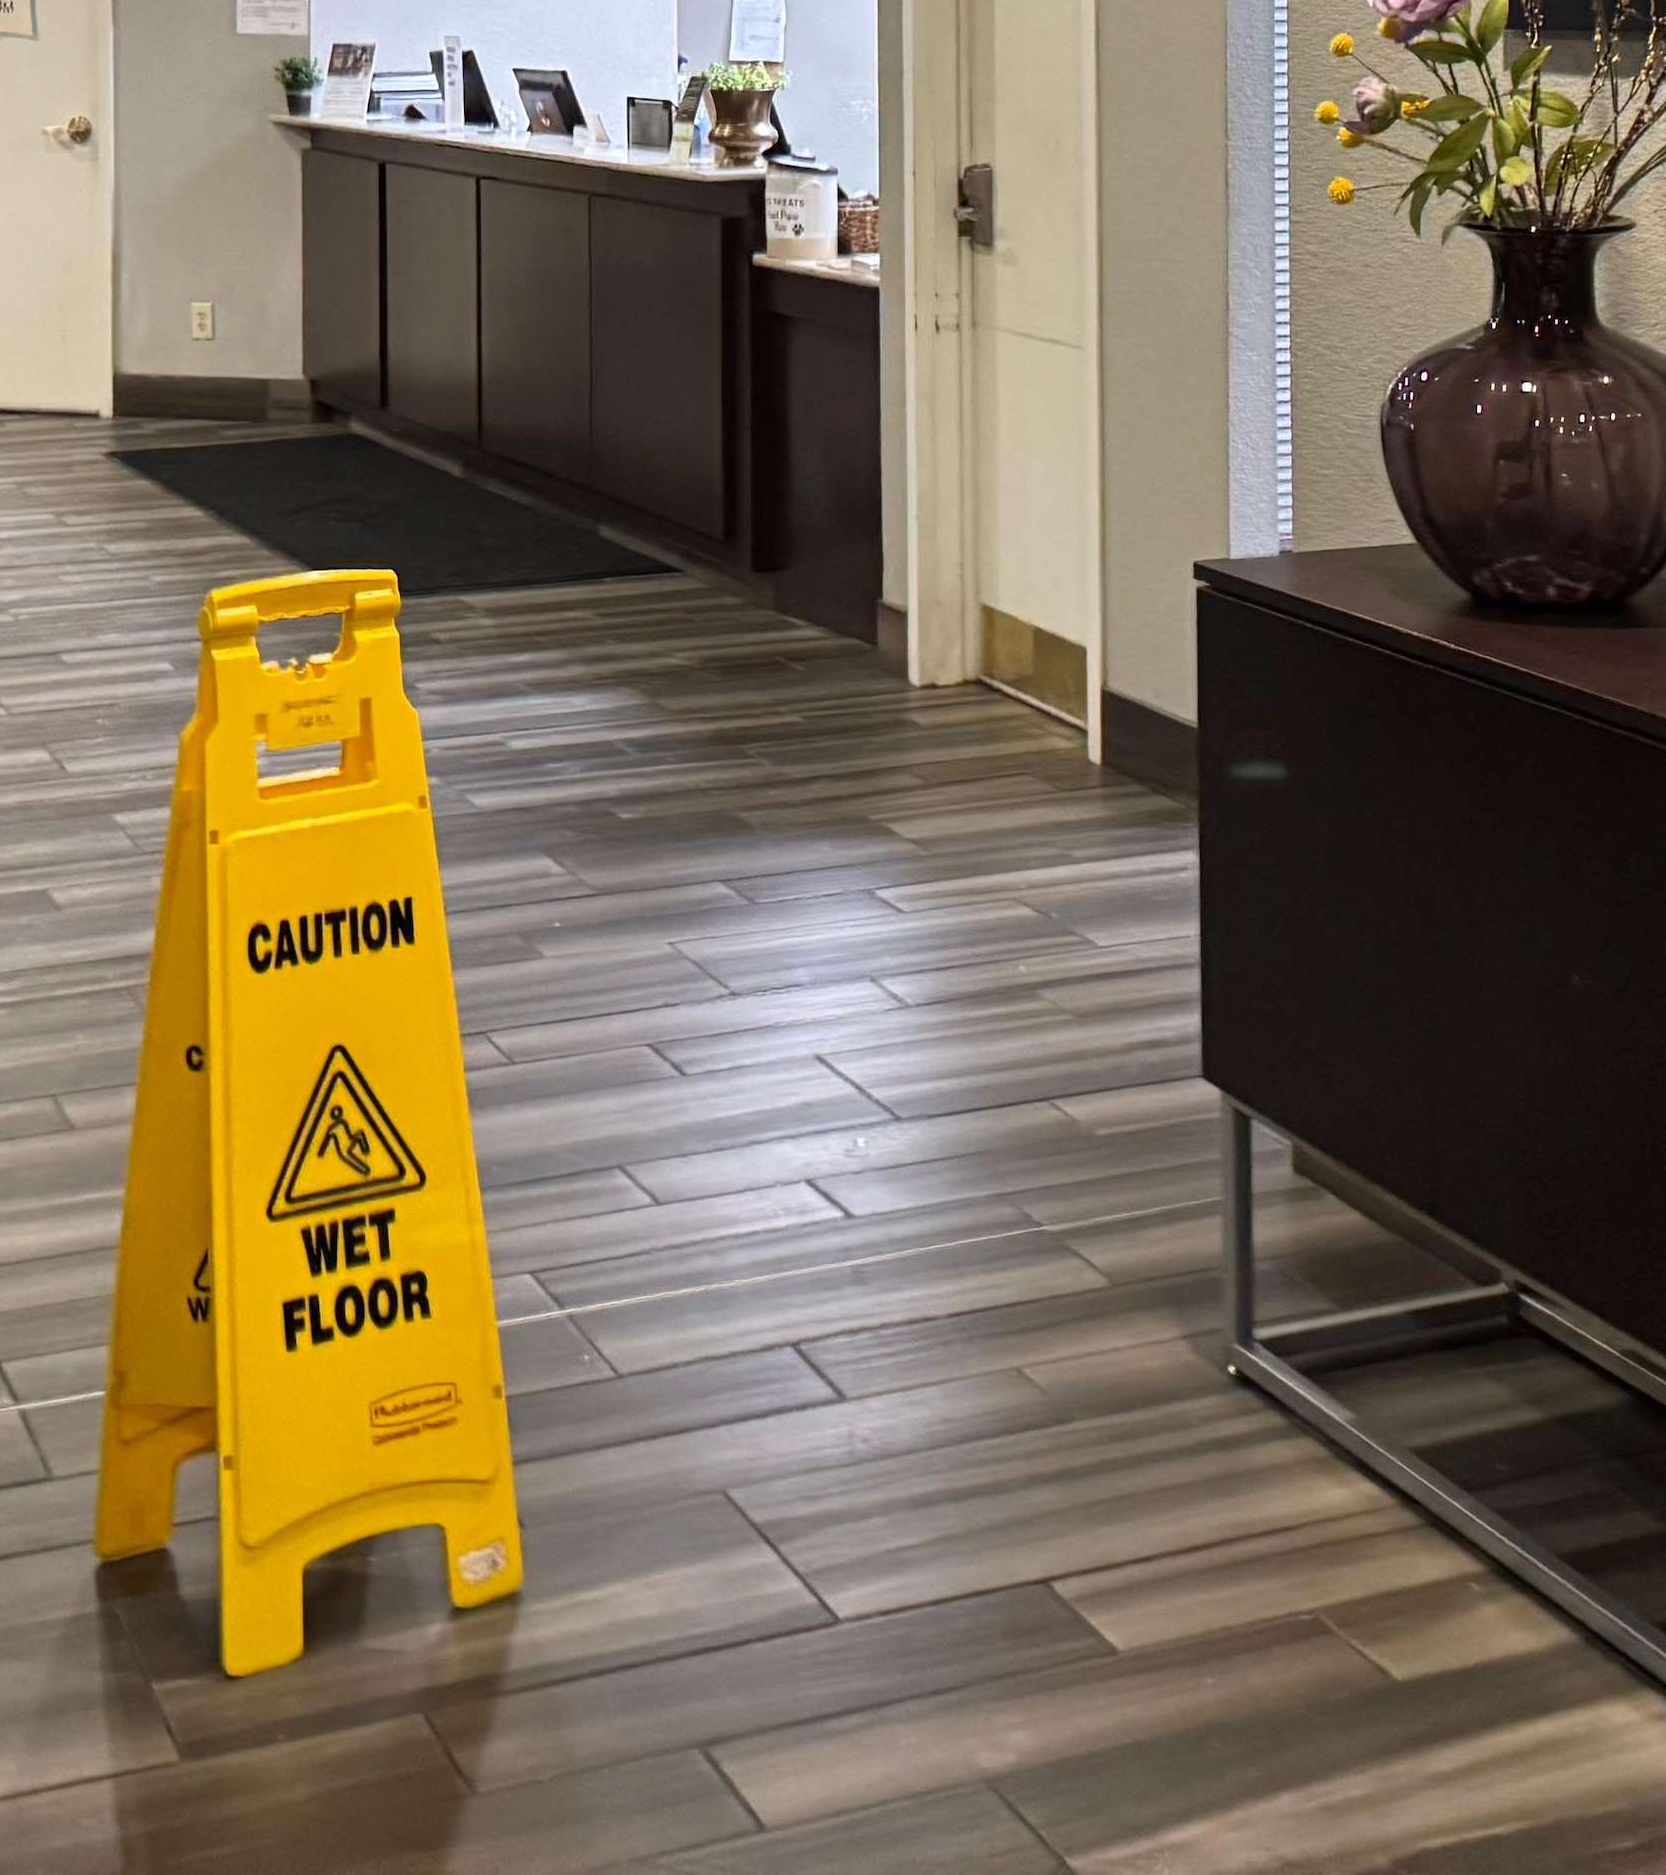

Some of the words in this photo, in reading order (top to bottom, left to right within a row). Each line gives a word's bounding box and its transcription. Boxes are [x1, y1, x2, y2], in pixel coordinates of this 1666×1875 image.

[247, 897, 416, 974] CAUTION
[301, 1210, 396, 1278] WET
[282, 1270, 432, 1353] FLOOR
